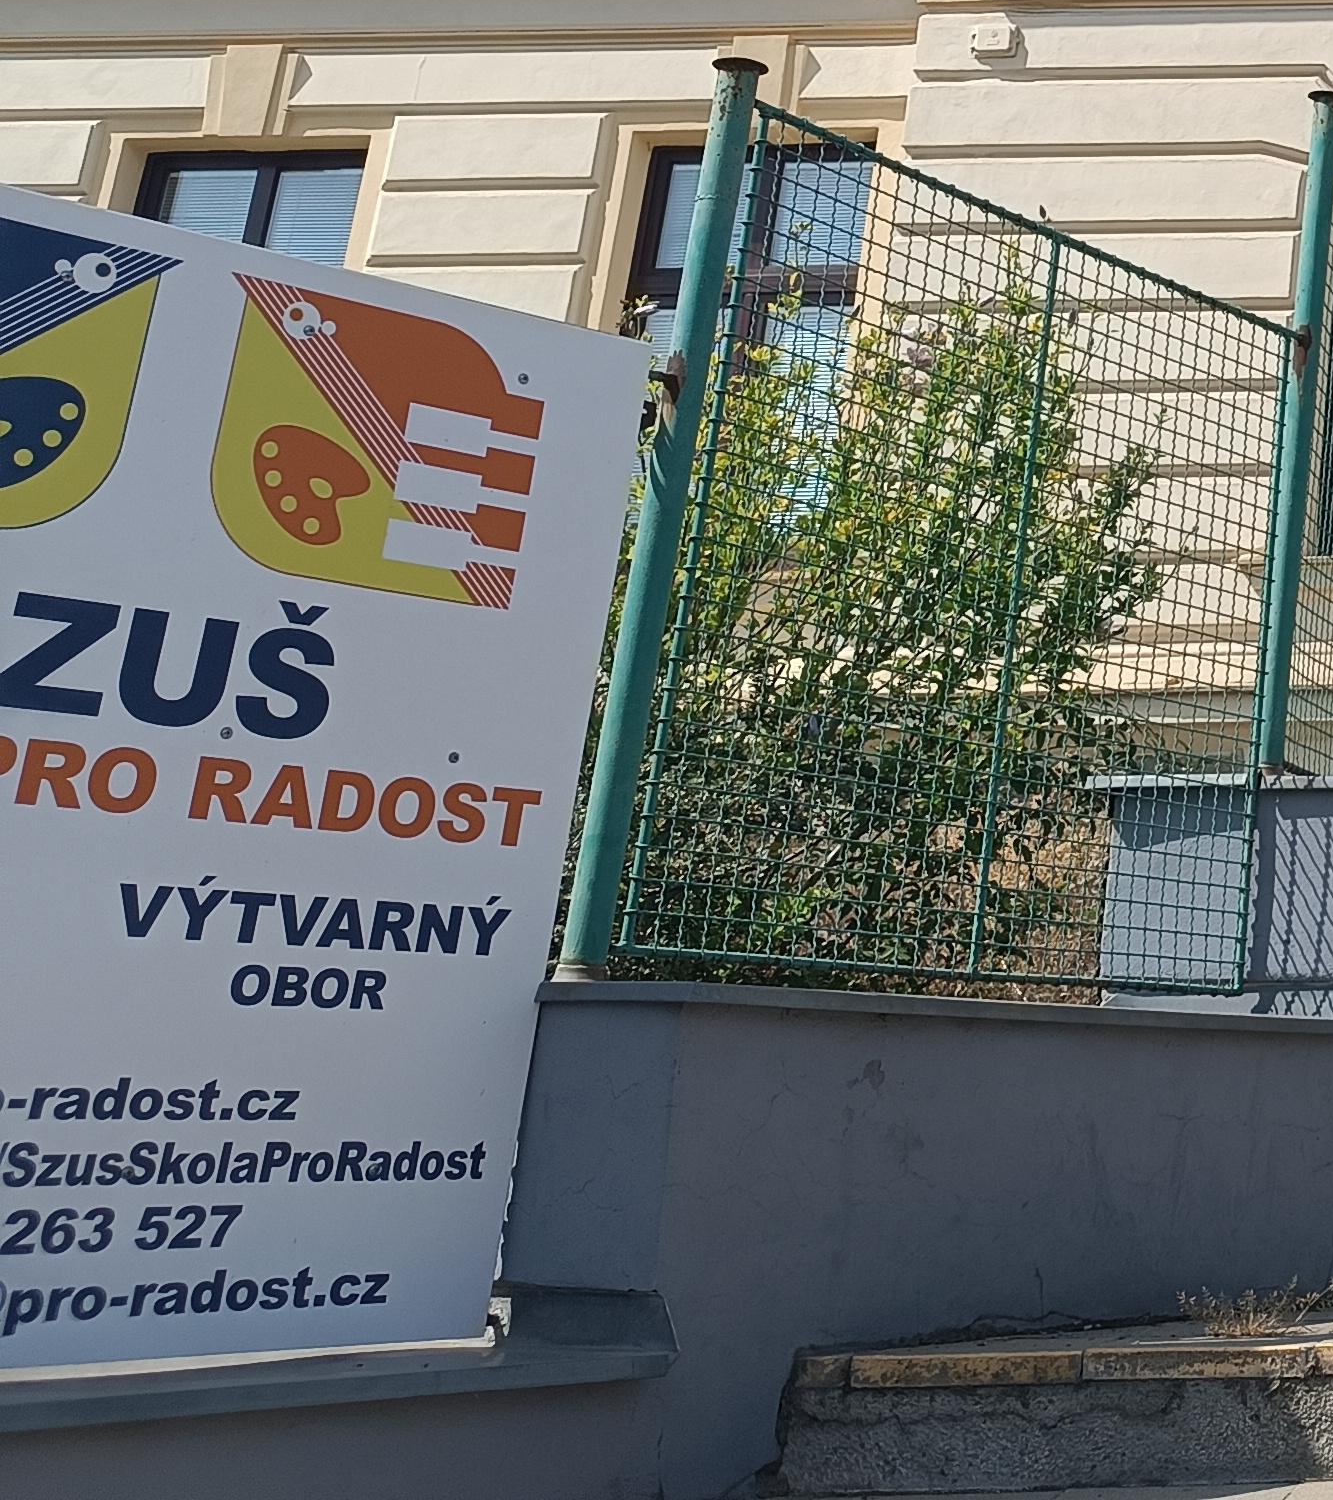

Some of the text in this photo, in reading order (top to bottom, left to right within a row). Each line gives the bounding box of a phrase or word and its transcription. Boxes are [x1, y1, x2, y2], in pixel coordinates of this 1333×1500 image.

[0, 591, 335, 740] ZUŠ
[188, 757, 542, 847] RADOST
[119, 875, 512, 957] VÝTVARNÝ
[230, 964, 387, 1011] OBOR
[0, 1077, 300, 1121] -radost.cz
[0, 1204, 244, 1256] 263 527
[0, 1266, 390, 1338] pro-radost.cz
